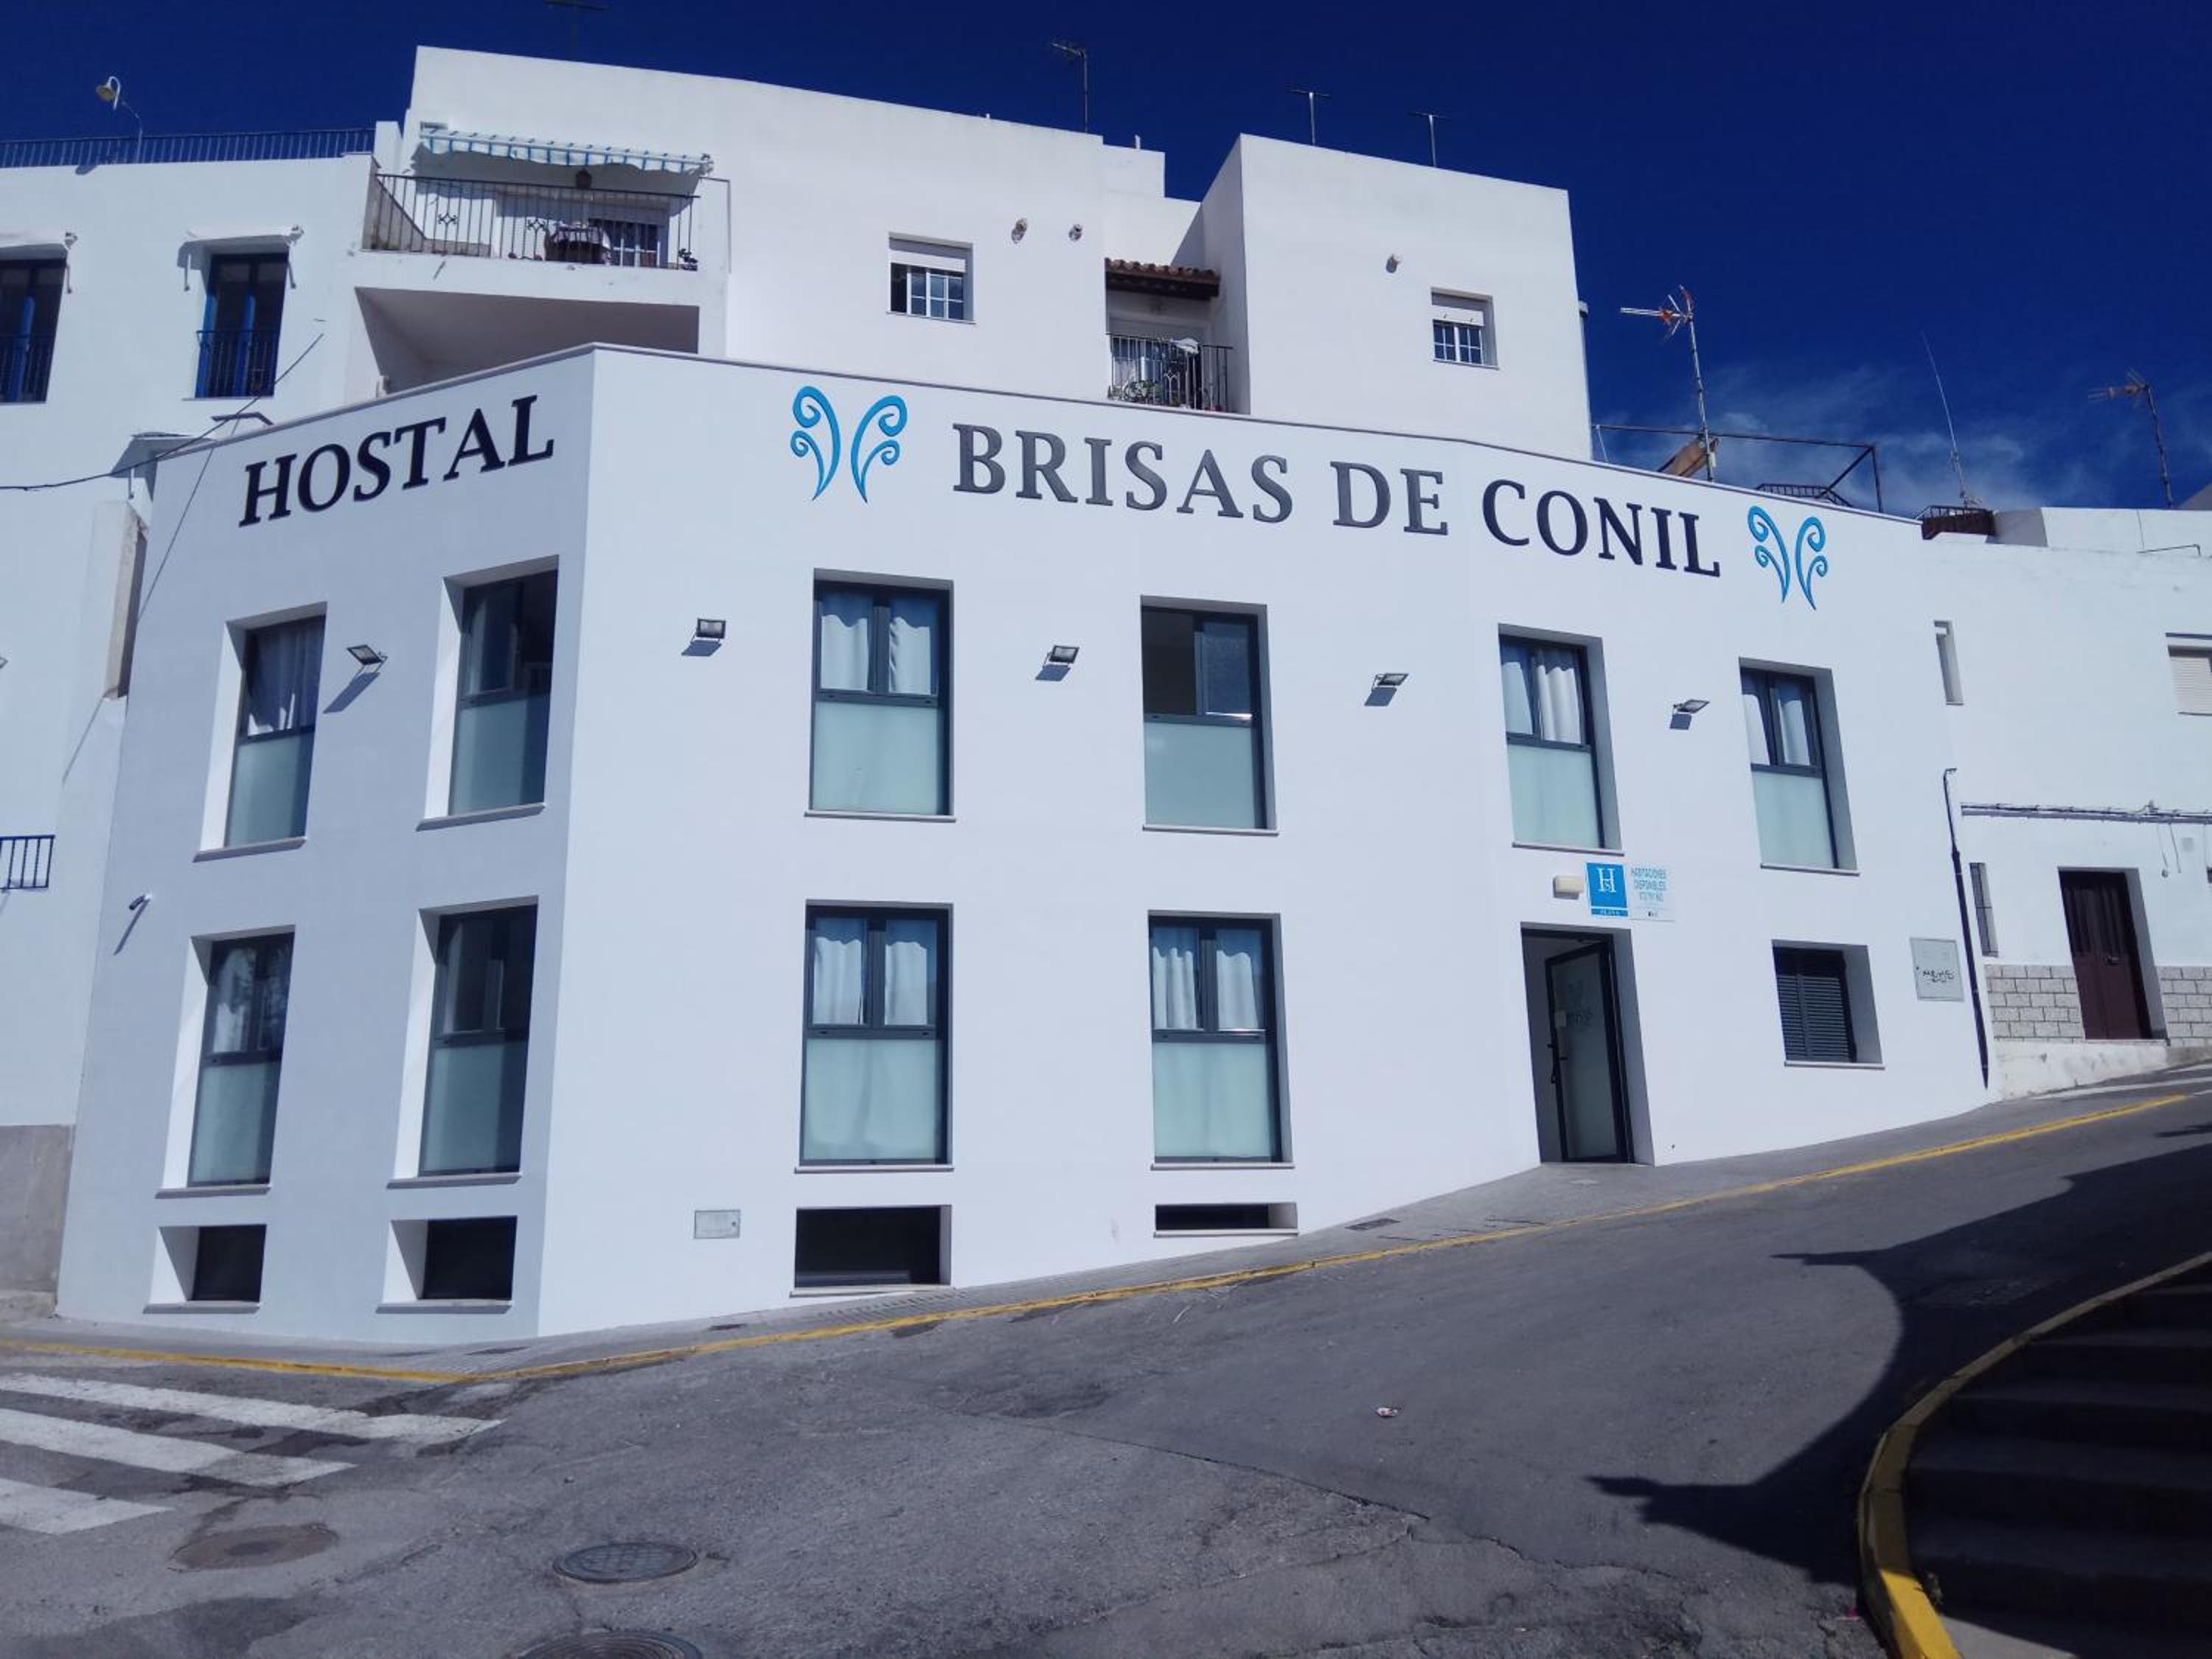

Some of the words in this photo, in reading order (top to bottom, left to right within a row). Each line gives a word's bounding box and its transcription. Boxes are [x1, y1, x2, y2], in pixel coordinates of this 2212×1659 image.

[237, 394, 555, 529] HOSTAL
[952, 422, 1294, 524] BRISAS
[1329, 461, 1449, 537] DE
[1481, 479, 1721, 579] CONIL
